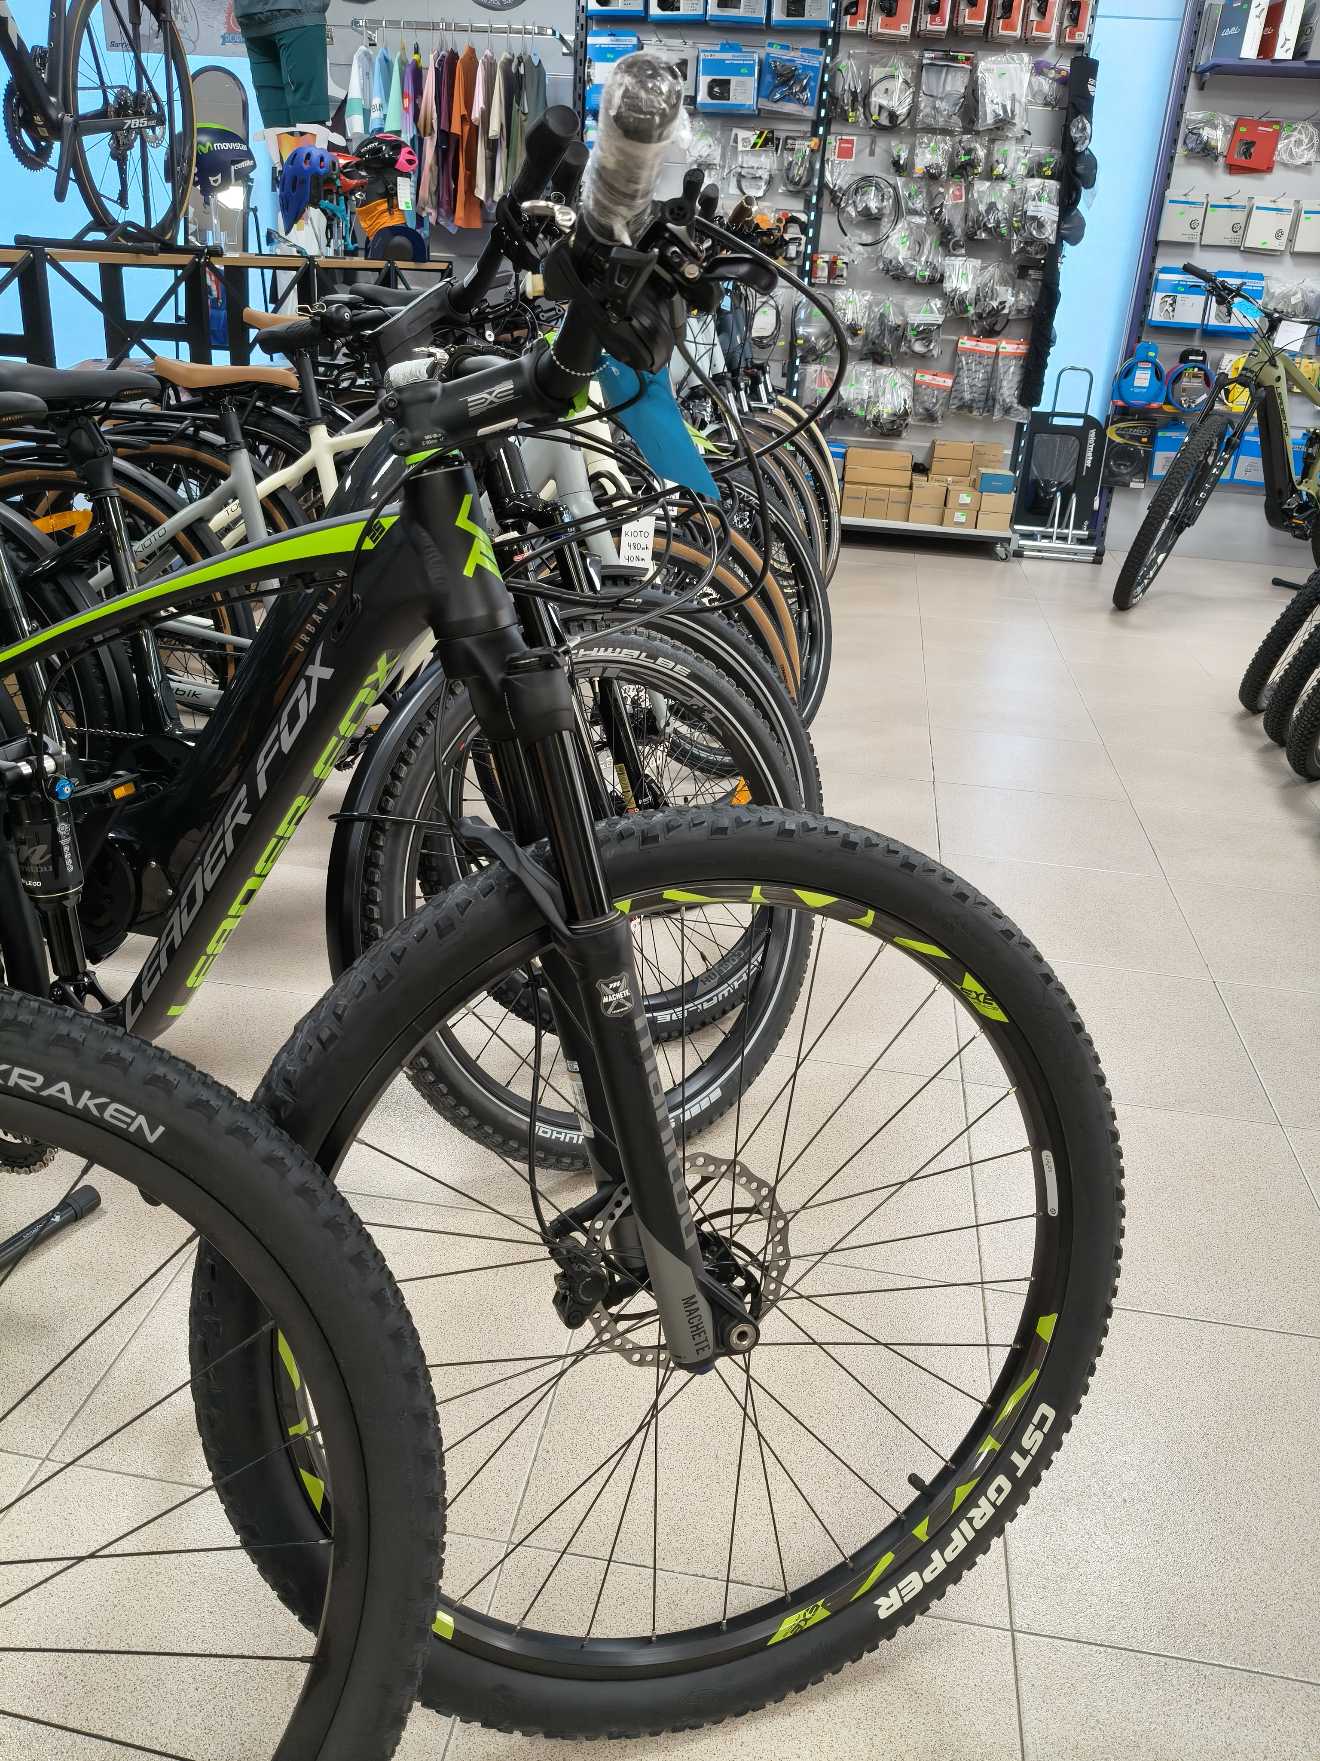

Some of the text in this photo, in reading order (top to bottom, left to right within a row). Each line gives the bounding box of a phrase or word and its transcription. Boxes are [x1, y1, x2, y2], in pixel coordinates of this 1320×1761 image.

[123, 117, 148, 130] 785
[133, 526, 167, 555] KIOTO
[624, 530, 651, 539] KIOTO
[294, 602, 329, 653] URBAN
[571, 647, 692, 678] HWALBE
[121, 641, 336, 1030] LEADER FOX
[602, 988, 632, 1004] MACHETE
[680, 1293, 712, 1357] MACHETE
[872, 1401, 1057, 1621] CST GRIPPER
